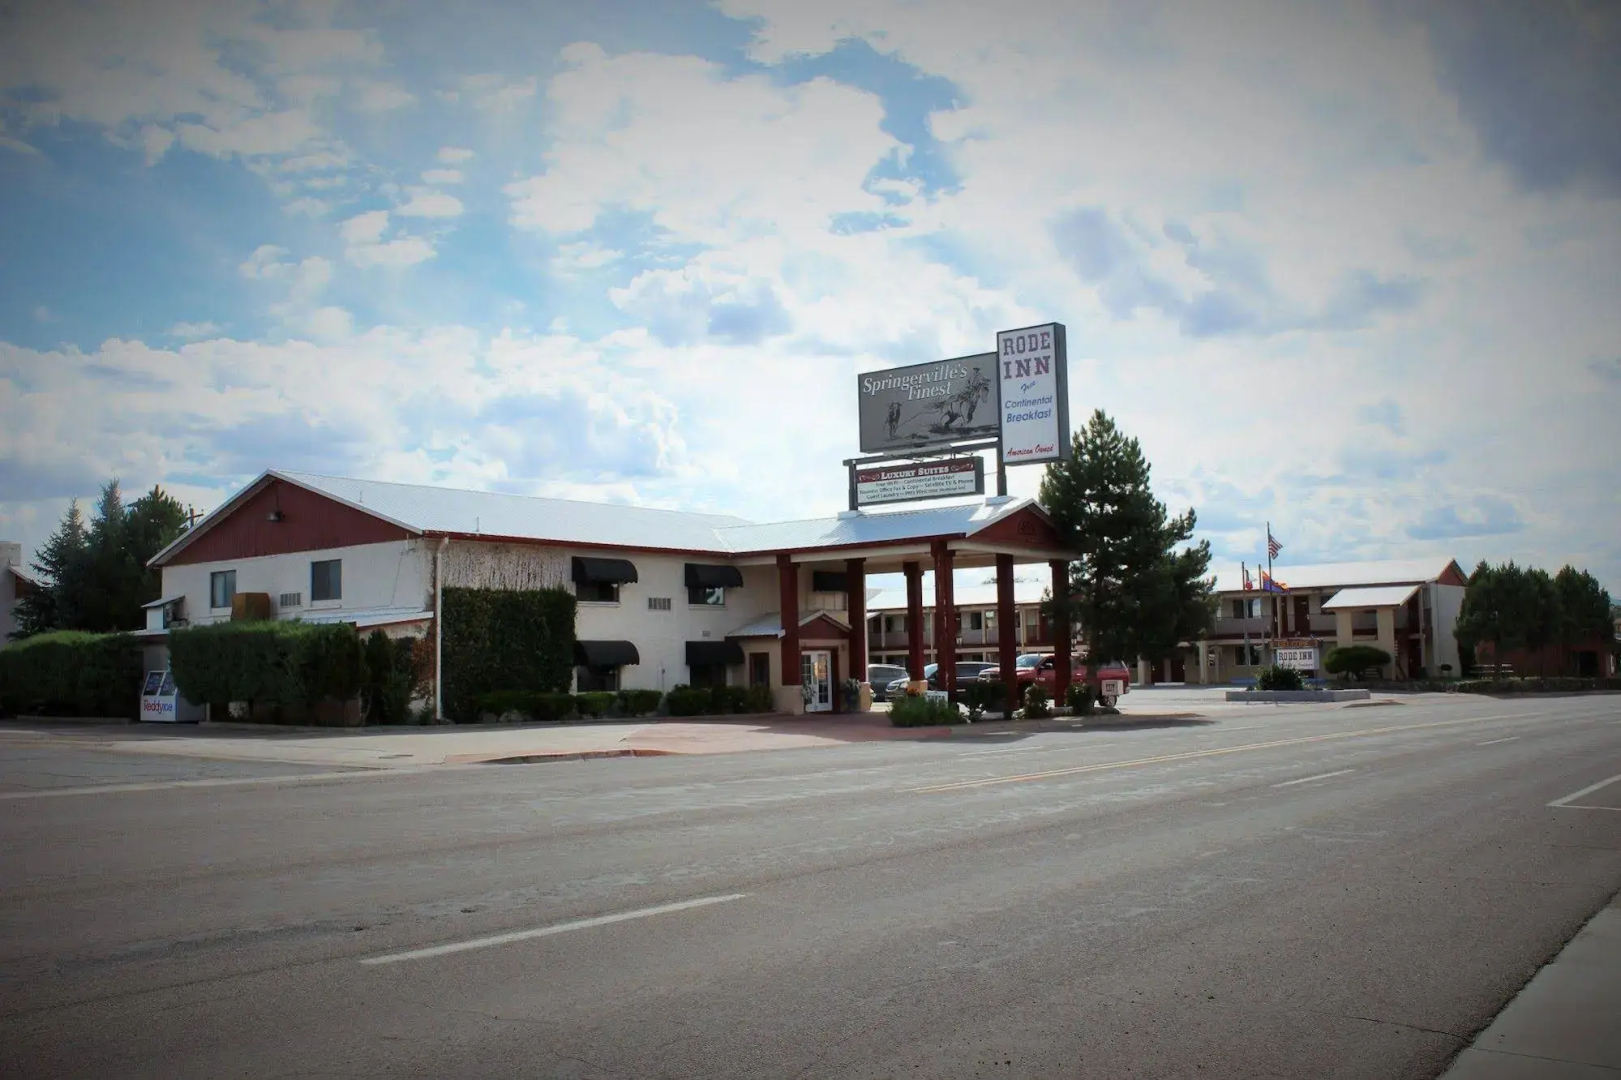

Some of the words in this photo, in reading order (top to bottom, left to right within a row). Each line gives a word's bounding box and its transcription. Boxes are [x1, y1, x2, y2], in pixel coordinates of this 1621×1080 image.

[1003, 331, 1051, 356] RODE
[1003, 355, 1051, 379] INN
[862, 364, 968, 396] Springerville's
[908, 381, 951, 400] Finest
[1020, 381, 1037, 394] Free
[1004, 395, 1053, 409] Continental
[1006, 409, 1052, 423] Breakfast
[1006, 447, 1033, 457] American
[880, 470, 916, 480] LUXURY
[917, 466, 949, 476] SUITES
[904, 476, 932, 485] Continental
[1278, 651, 1298, 661] RODE
